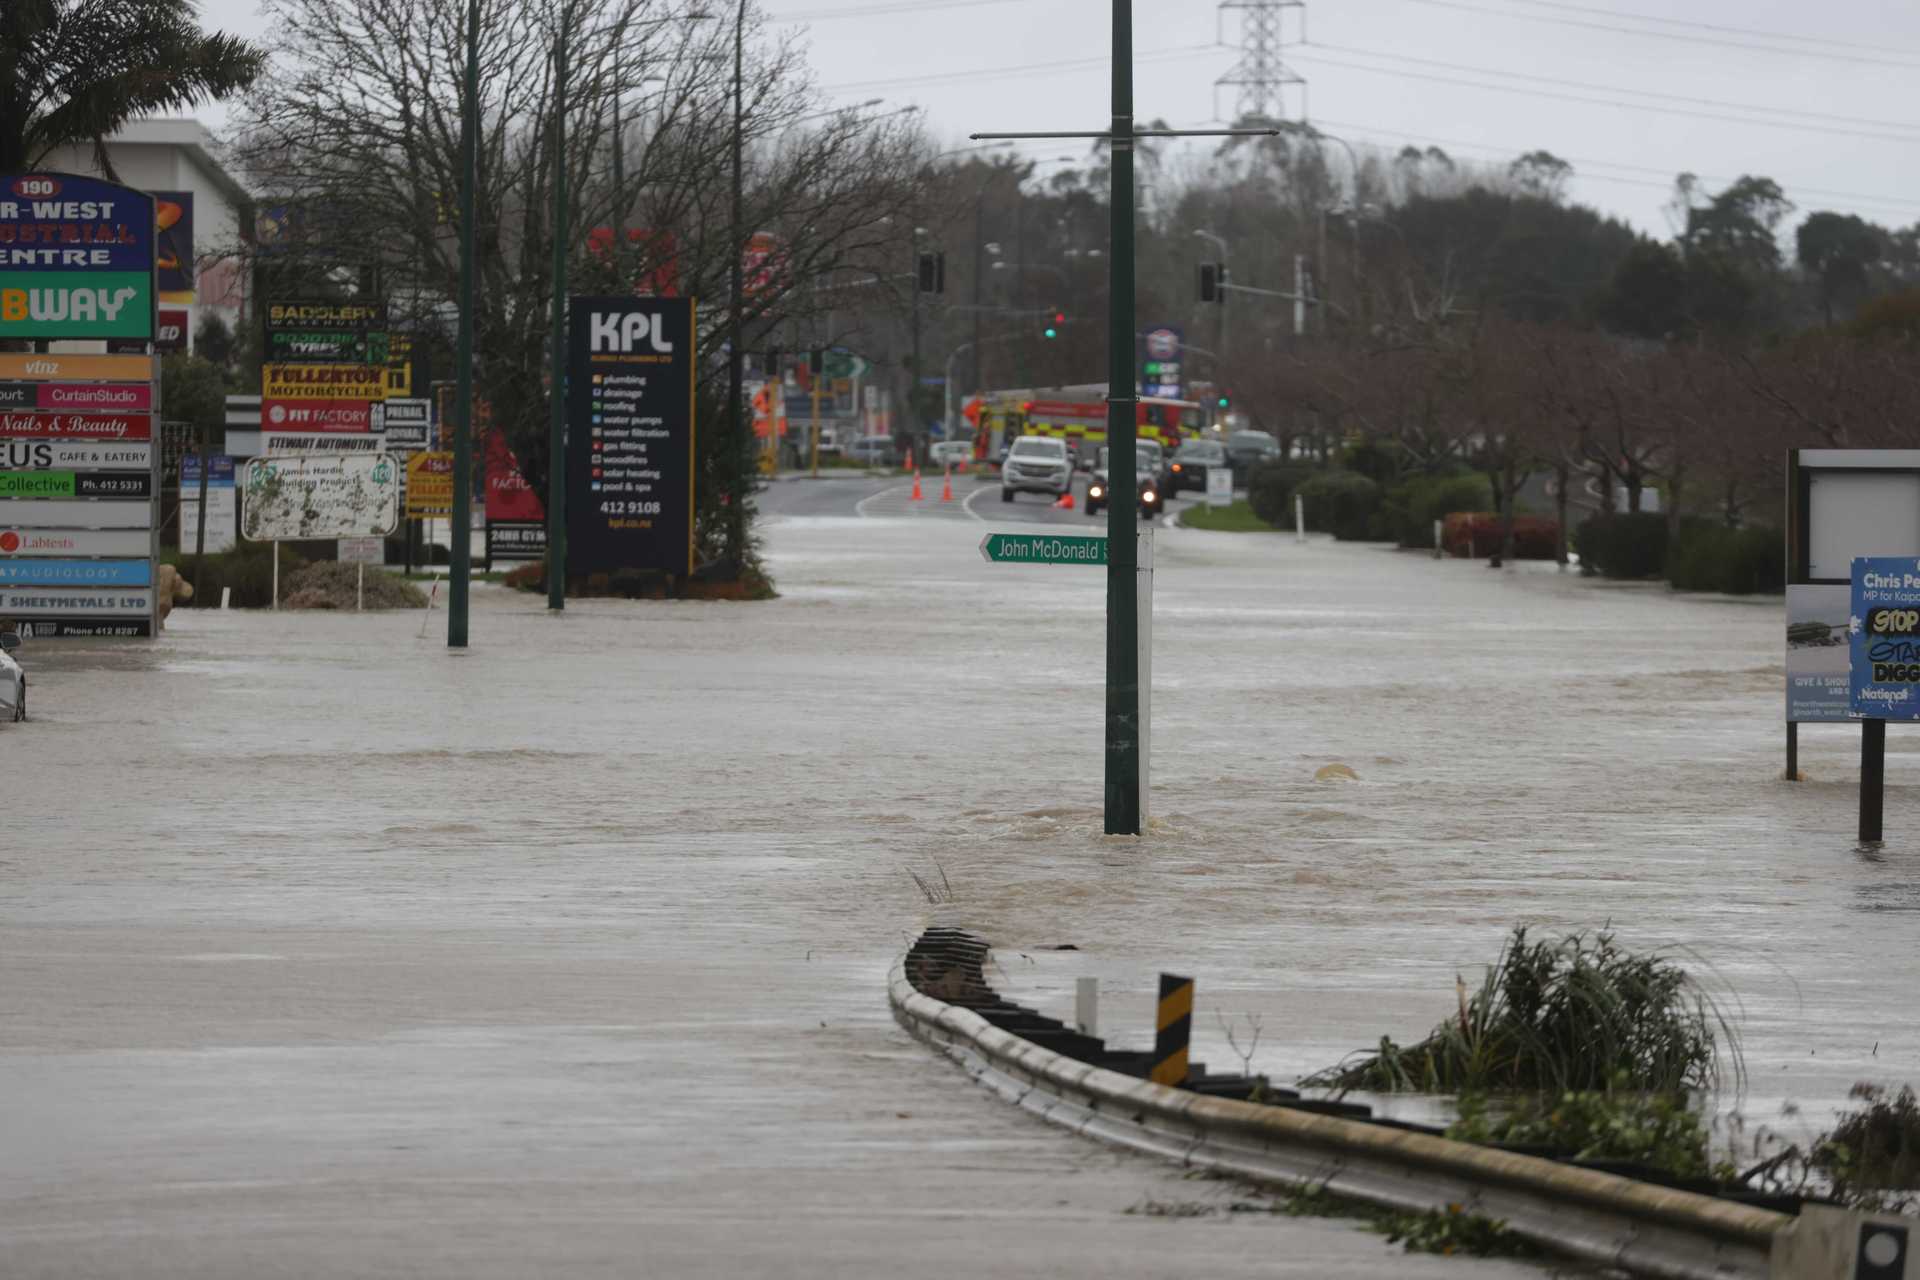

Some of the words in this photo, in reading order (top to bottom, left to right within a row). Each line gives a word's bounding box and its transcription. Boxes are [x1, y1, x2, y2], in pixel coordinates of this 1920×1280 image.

[22, 181, 54, 195] 190
[0, 201, 115, 220] R-WEST
[2, 286, 137, 321] BWAY
[591, 312, 673, 352] KPL
[271, 368, 381, 384] FULLERTON
[52, 389, 137, 402] CurtainStudio
[270, 386, 383, 396] MOTORCYCLES
[289, 409, 312, 421] FIT
[313, 410, 367, 423] FACTORY
[0, 414, 42, 432] Nails
[48, 416, 61, 432] &
[67, 416, 128, 436] Beauty
[269, 438, 315, 449] STEWART
[316, 438, 379, 449] AUTOMOTIVE
[60, 452, 87, 462] CAFE
[91, 453, 99, 461] &
[104, 452, 147, 462] EATERY
[82, 480, 98, 490] Ph.
[100, 480, 117, 489] 412
[600, 501, 625, 513] 412
[628, 501, 661, 514] 9108
[23, 536, 74, 549] Labtests
[998, 539, 1028, 557] John
[1032, 540, 1099, 560] McDonald
[1864, 573, 1900, 588] Chris
[10, 597, 116, 608] SHEETMETALS
[120, 597, 147, 608] LTD
[1864, 592, 1879, 600] MP
[1880, 592, 1893, 600] for
[1873, 609, 1919, 632] STOP
[64, 626, 93, 636] Phone
[1861, 687, 1908, 702] National
